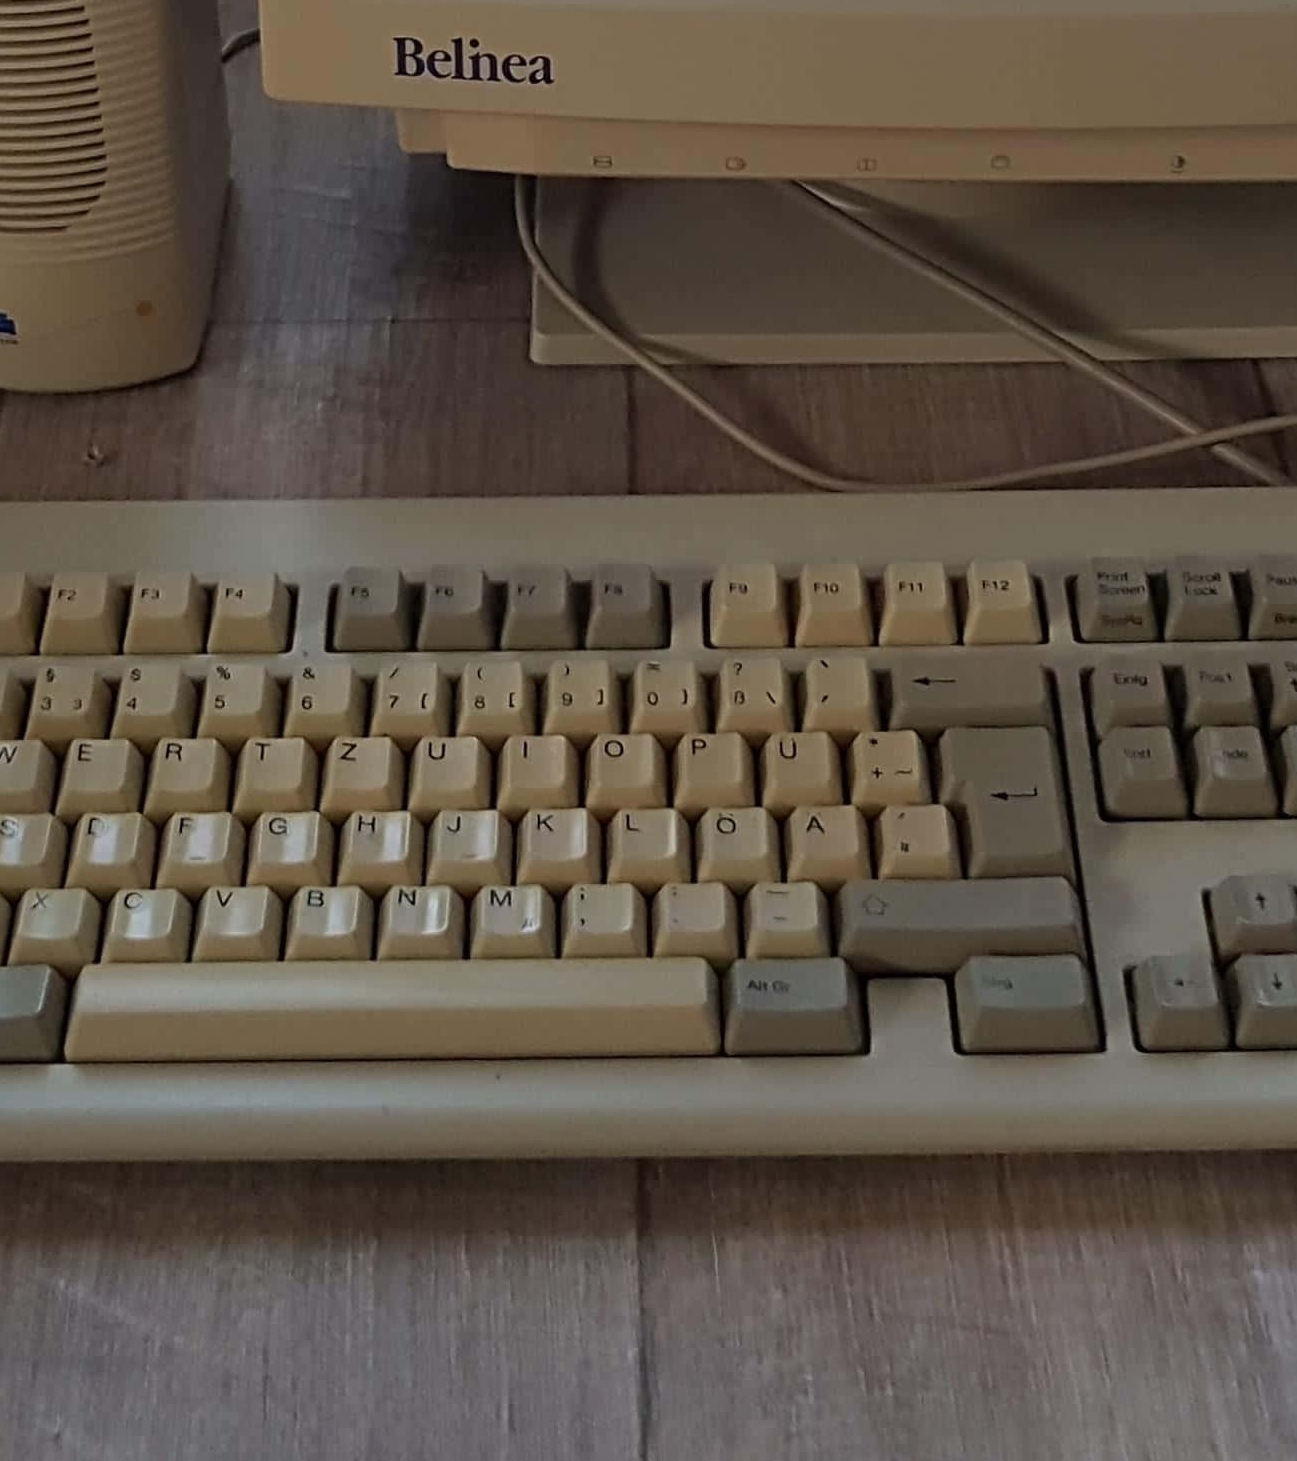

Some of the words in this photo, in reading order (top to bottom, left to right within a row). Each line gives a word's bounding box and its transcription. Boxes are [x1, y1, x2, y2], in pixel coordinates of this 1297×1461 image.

[393, 37, 555, 85] Belinea
[225, 587, 244, 599] F4
[350, 586, 370, 598] F5
[435, 585, 454, 597] F6
[729, 582, 748, 594] F9
[813, 582, 840, 593] F10
[898, 581, 924, 592] F11
[981, 580, 1010, 591] F12
[57, 590, 77, 601] F2
[141, 588, 160, 600] F3
[216, 666, 231, 680] %
[302, 666, 315, 680] &
[40, 697, 52, 711] 3
[126, 697, 137, 710] 4
[214, 696, 225, 709] 5
[302, 696, 313, 710] 6
[389, 695, 399, 709] 7
[474, 696, 485, 709] 8
[562, 692, 573, 706] 9
[77, 743, 93, 761] E
[165, 743, 182, 761] R
[255, 743, 270, 761] T
[340, 743, 357, 761] Z
[428, 742, 446, 760] U
[604, 740, 624, 758] O
[692, 739, 707, 757] P
[0, 819, 18, 837] S
[87, 817, 106, 836] D
[179, 817, 194, 834] F
[269, 817, 288, 835] G
[357, 816, 376, 832] H
[447, 816, 461, 833] J
[537, 814, 554, 832] K
[625, 814, 639, 831] L
[716, 812, 736, 834] Ö
[32, 893, 48, 909] X
[123, 891, 143, 910] C
[216, 890, 233, 907] V
[306, 890, 325, 908] B
[397, 890, 416, 907] N
[490, 889, 512, 907] M
[746, 979, 769, 992] Alt
